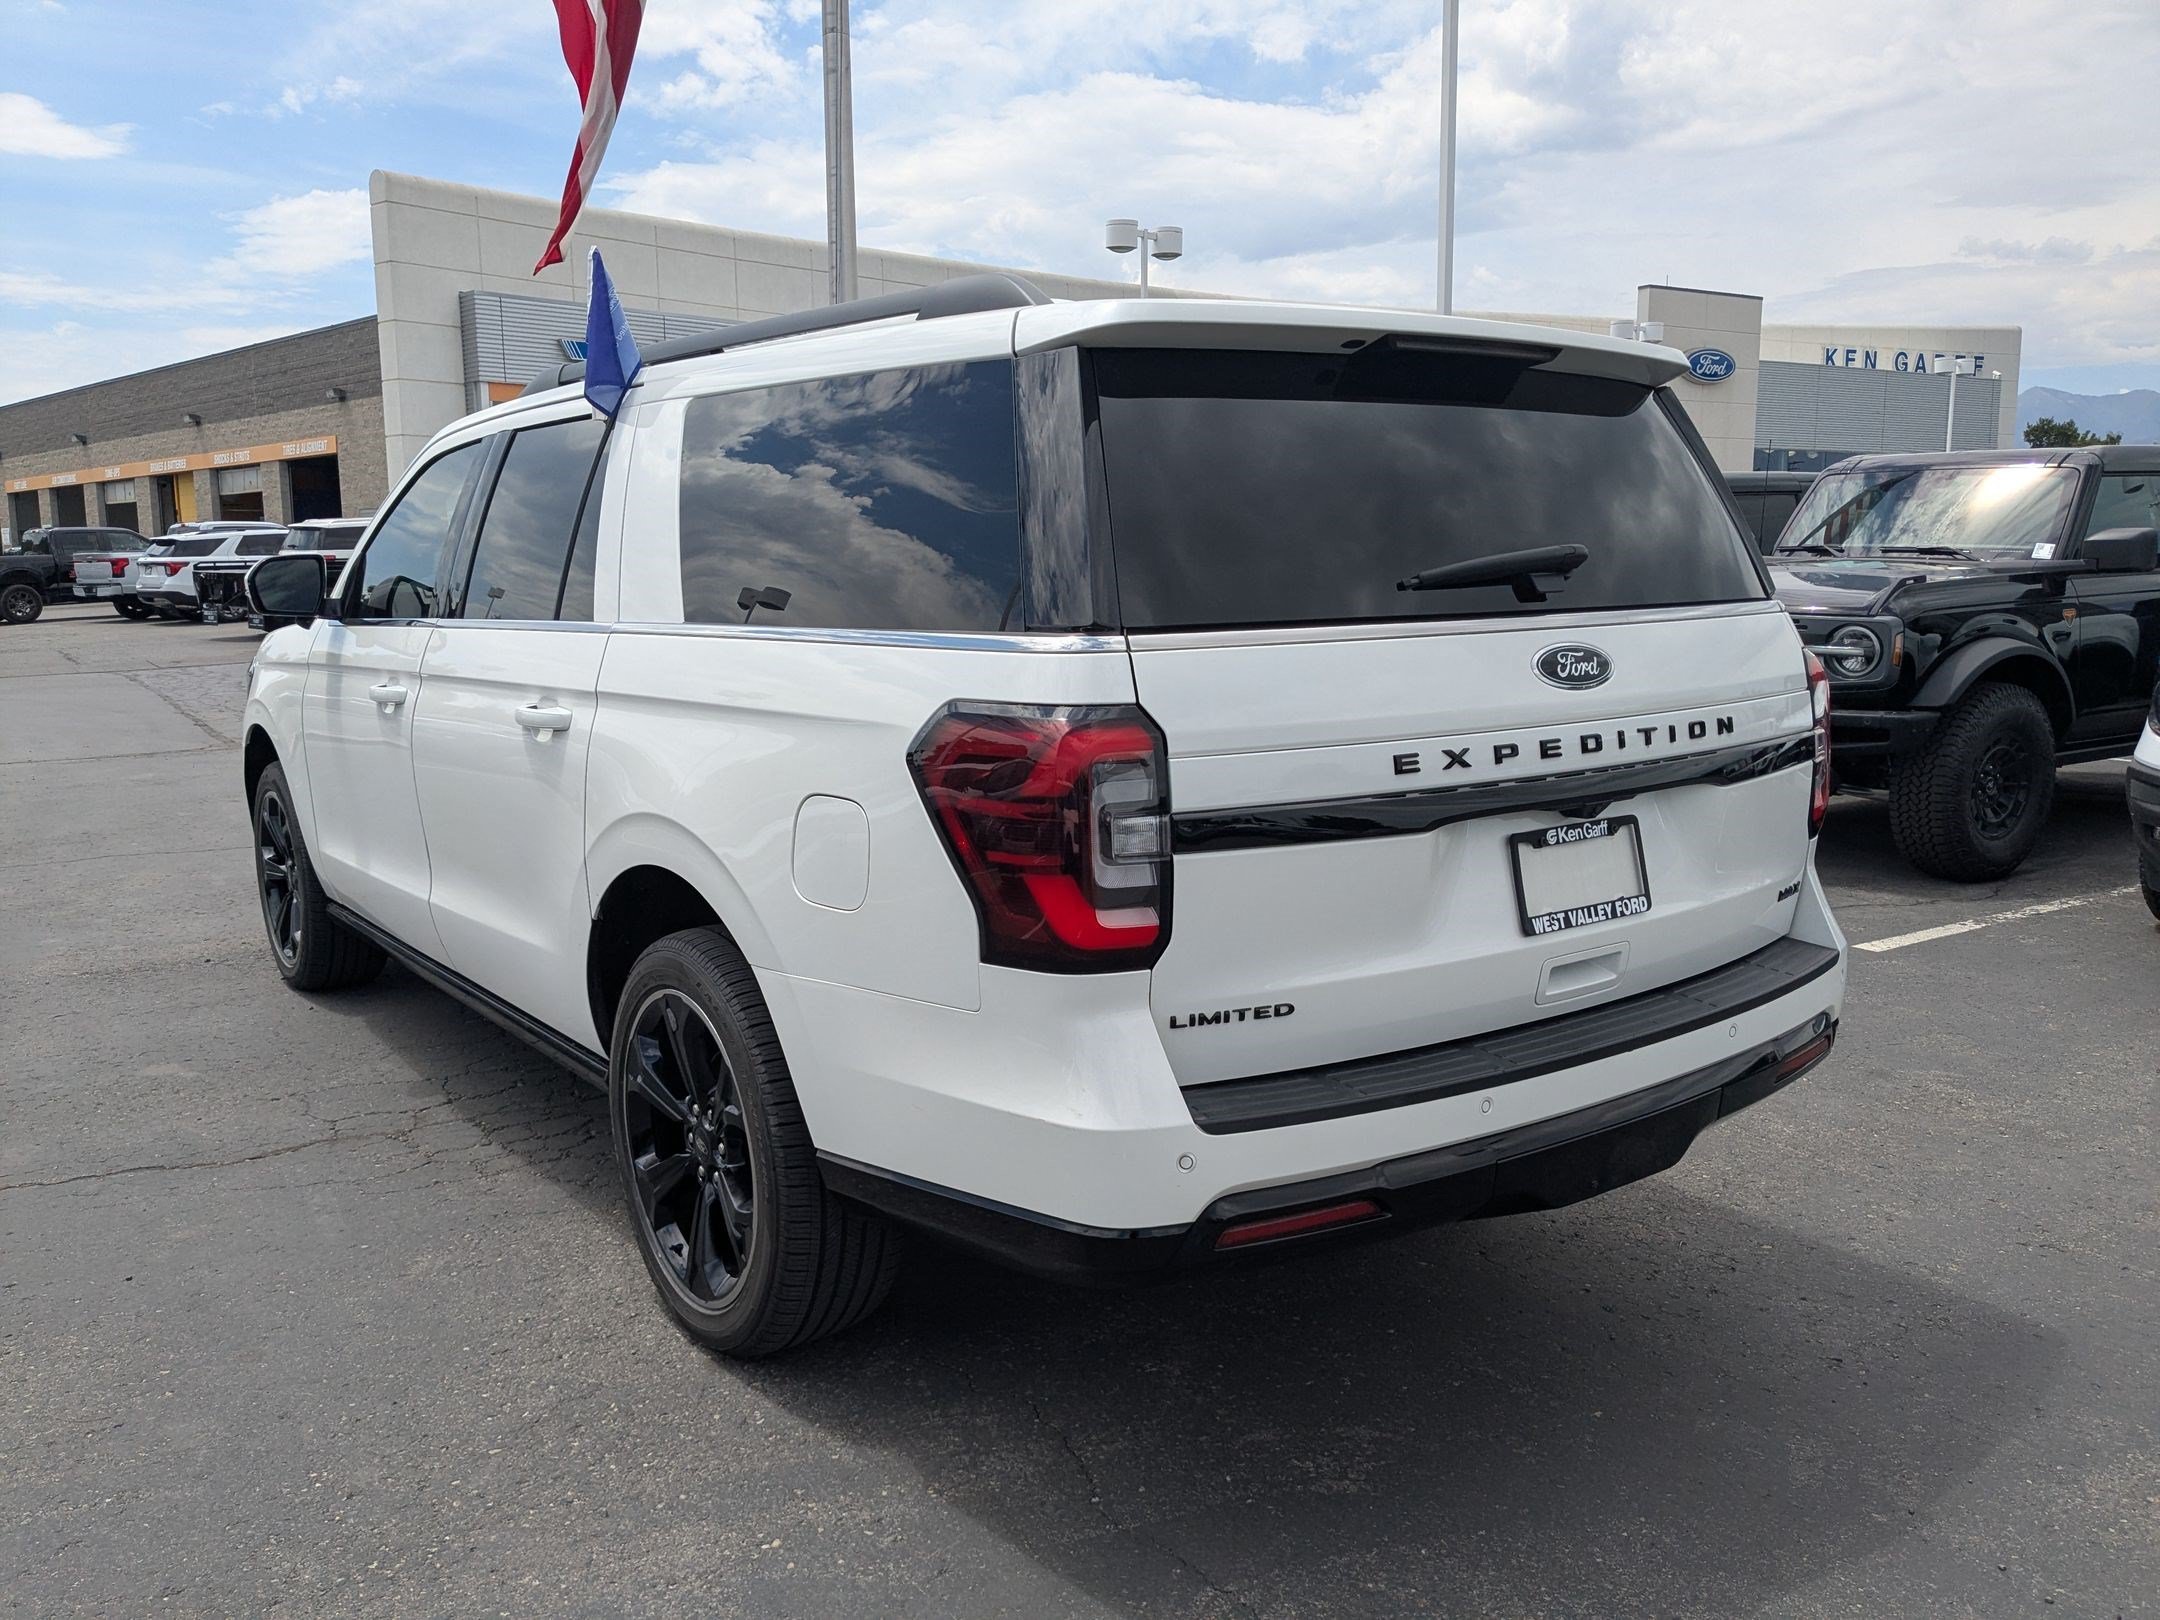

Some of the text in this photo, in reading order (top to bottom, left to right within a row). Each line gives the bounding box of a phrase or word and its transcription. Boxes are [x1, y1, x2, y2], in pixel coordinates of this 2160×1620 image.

[1696, 354, 1728, 375] Ford
[1825, 348, 1985, 377] KEN GAF
[1557, 651, 1600, 678] Ford
[1393, 716, 1734, 775] EXPEDITION
[1531, 896, 1648, 935] WEST VALLEY FORD
[1169, 1003, 1296, 1029] LIMITED
